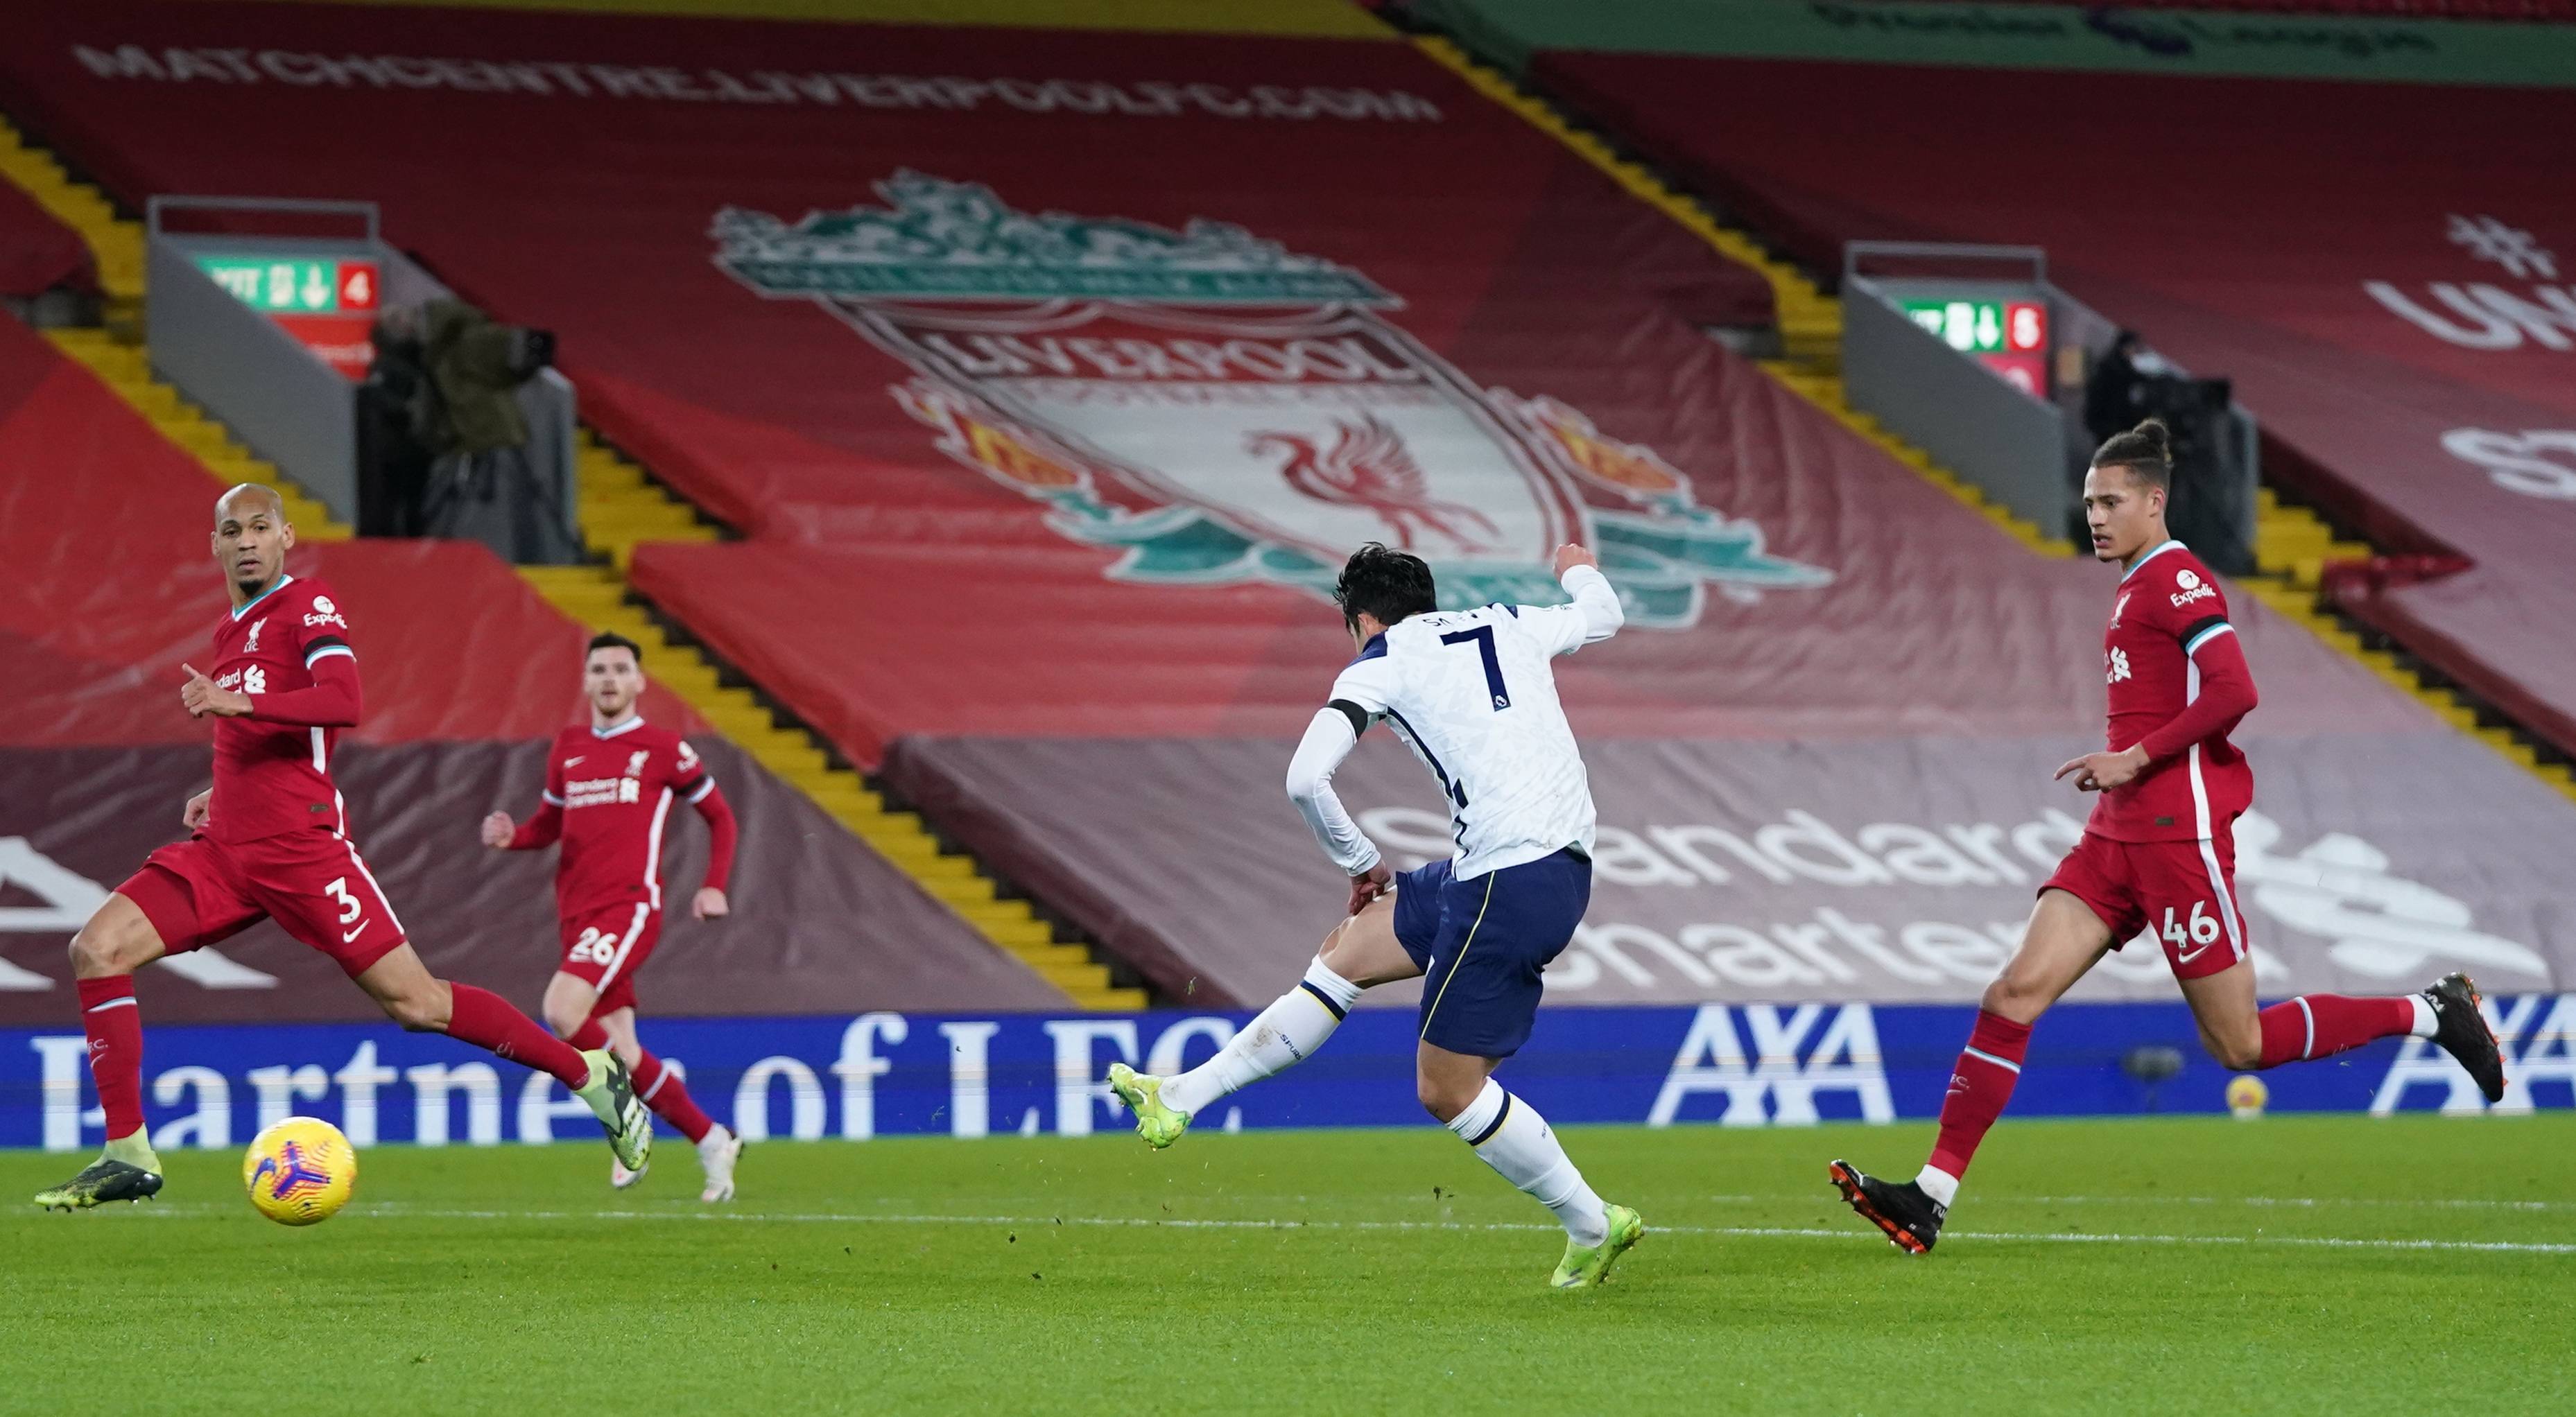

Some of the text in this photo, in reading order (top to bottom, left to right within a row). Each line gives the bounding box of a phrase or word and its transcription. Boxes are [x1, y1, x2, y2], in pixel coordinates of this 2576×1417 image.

[345, 270, 372, 303] 4
[2362, 280, 2576, 349] UN
[921, 333, 1426, 383] LIVERPOOL
[2438, 426, 2576, 501] S
[1440, 625, 1512, 712] 7
[1358, 806, 2086, 887] Sandar
[324, 876, 362, 925] 3
[2162, 900, 2220, 949] 46
[567, 925, 619, 966] 26
[732, 1010, 909, 1142] of
[1279, 1034, 1304, 1061] SPURS
[1645, 1000, 1898, 1128] AXA
